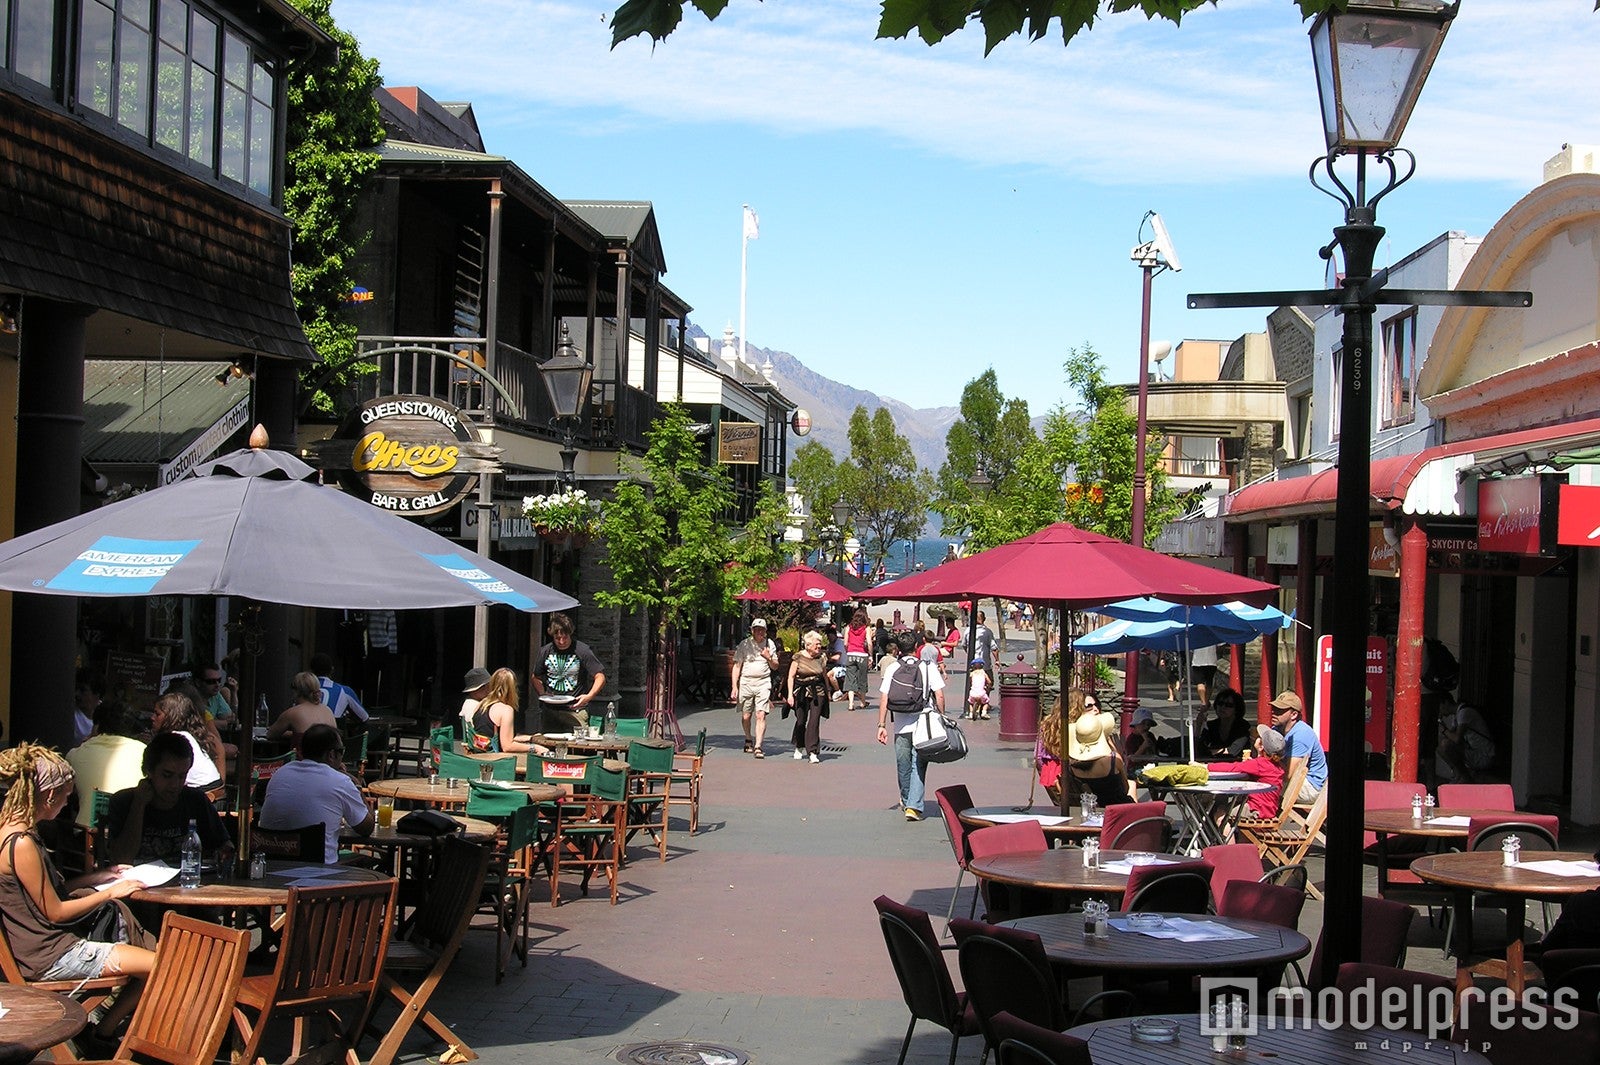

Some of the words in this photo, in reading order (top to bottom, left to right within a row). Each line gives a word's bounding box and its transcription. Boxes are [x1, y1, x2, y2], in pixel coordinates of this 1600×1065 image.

[1354, 347, 1362, 390] 6239
[165, 448, 197, 485] custom
[221, 402, 249, 436] clothin
[371, 492, 398, 510] BAR
[399, 499, 410, 510] &
[412, 491, 449, 510] GRILL
[501, 519, 511, 537] ALL
[1431, 539, 1466, 550] SKYCITY
[81, 550, 179, 563] AMERICAN
[87, 565, 171, 575] EXPRESS
